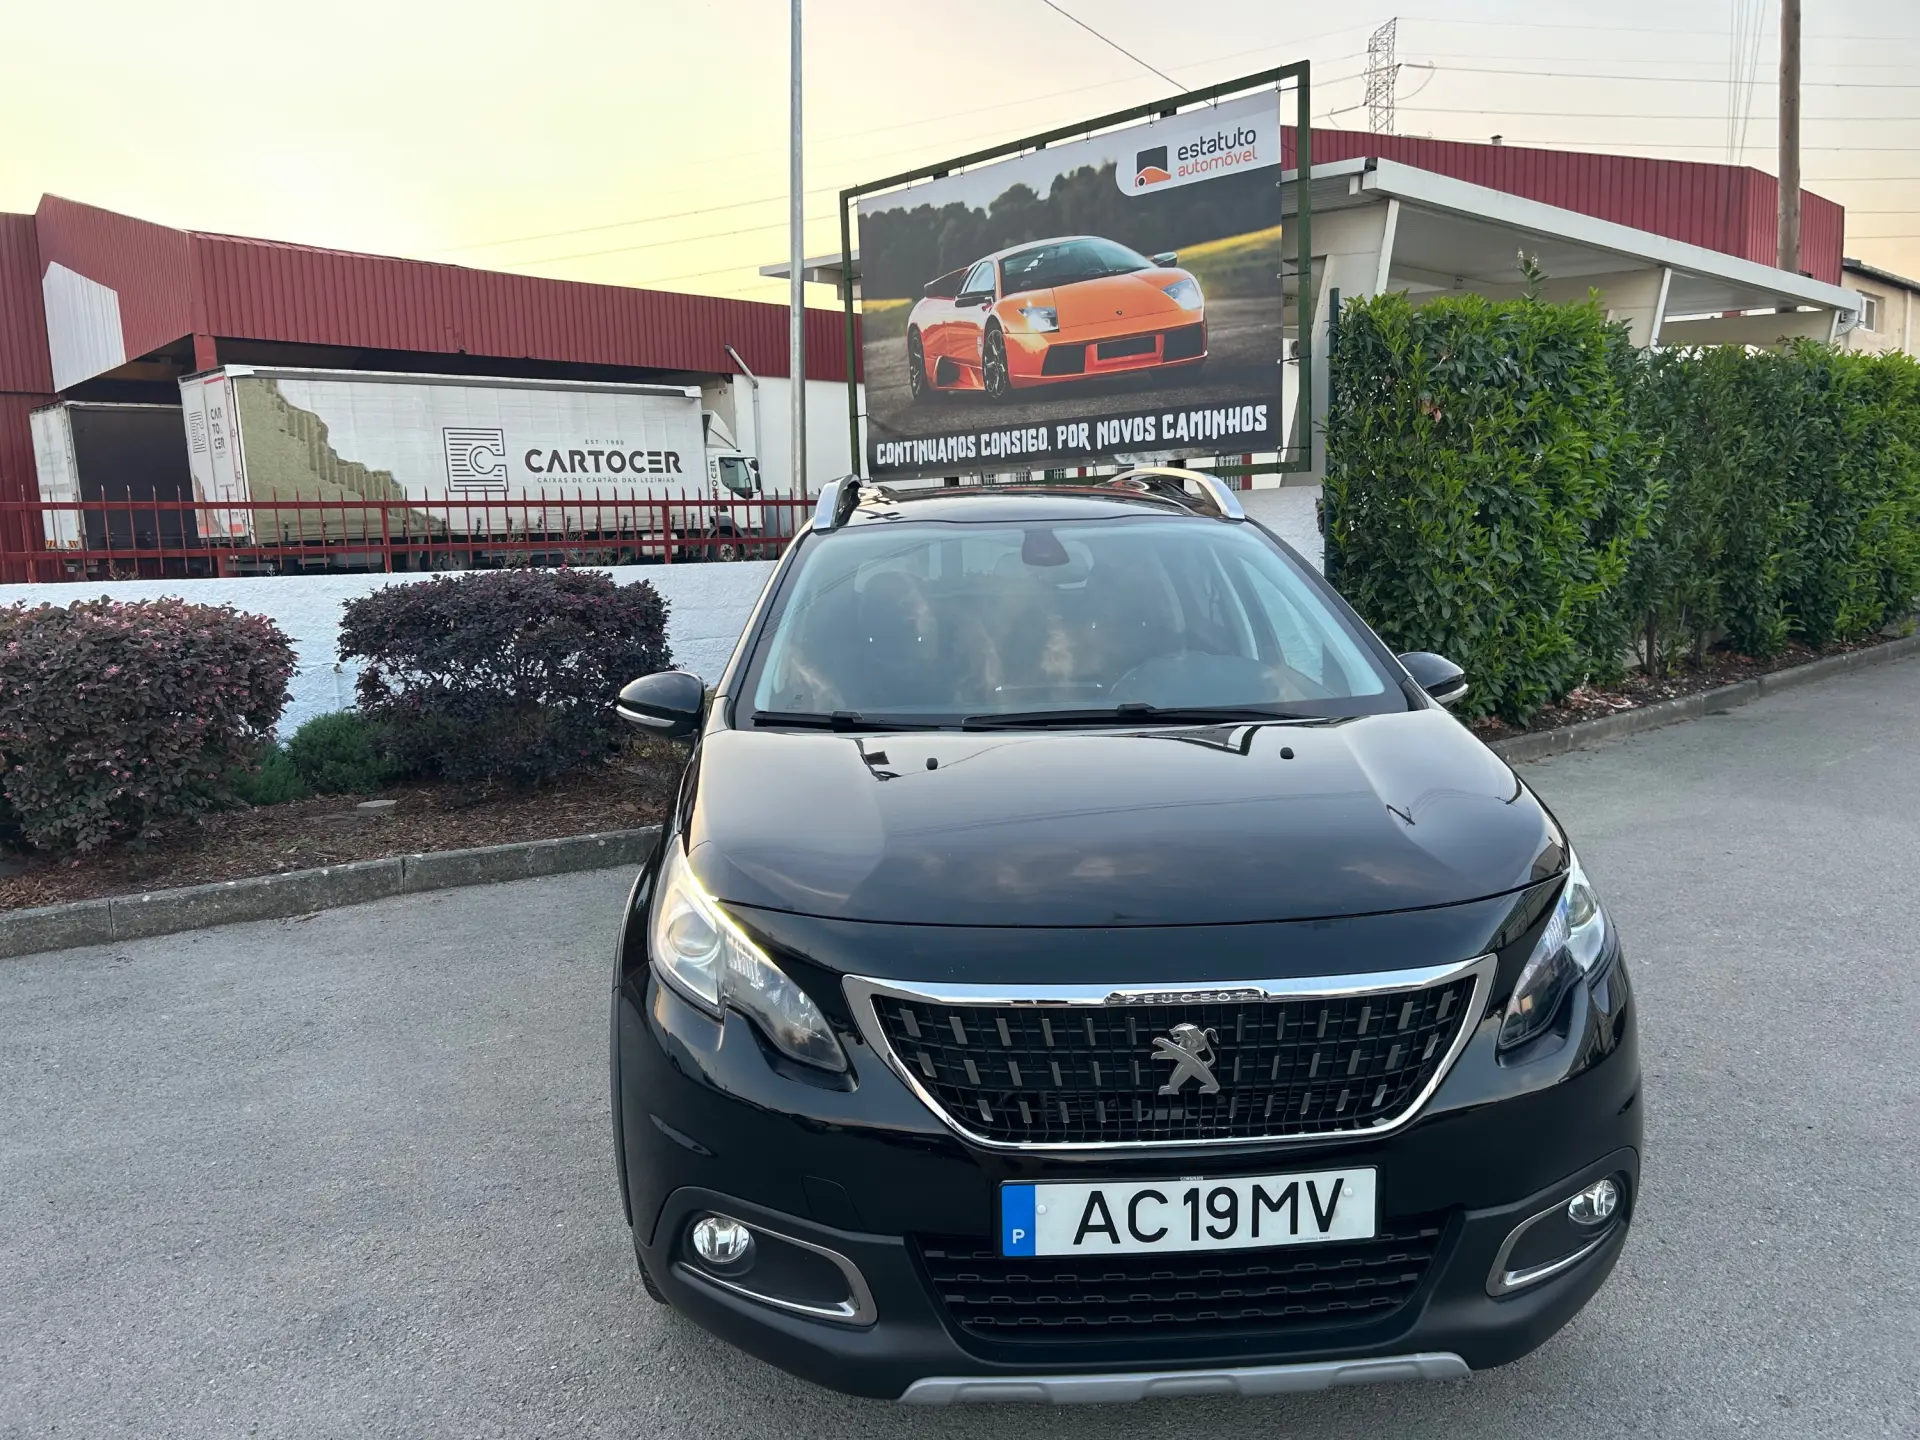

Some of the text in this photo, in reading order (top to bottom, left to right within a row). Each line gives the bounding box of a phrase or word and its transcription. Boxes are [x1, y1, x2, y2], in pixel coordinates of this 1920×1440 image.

[1177, 126, 1257, 161] estatuto
[1178, 145, 1258, 177] automóvel
[876, 435, 976, 467] CONTINUAMOS
[1056, 422, 1092, 451] POR
[1096, 416, 1156, 450] NOVOS
[1162, 404, 1268, 442] CAMINHOS
[524, 448, 683, 474] CARTOCER
[537, 476, 569, 484] CAIXAS
[572, 476, 583, 484] DE
[1124, 991, 1249, 1005] PEUGEOT
[1012, 1228, 1026, 1245] P
